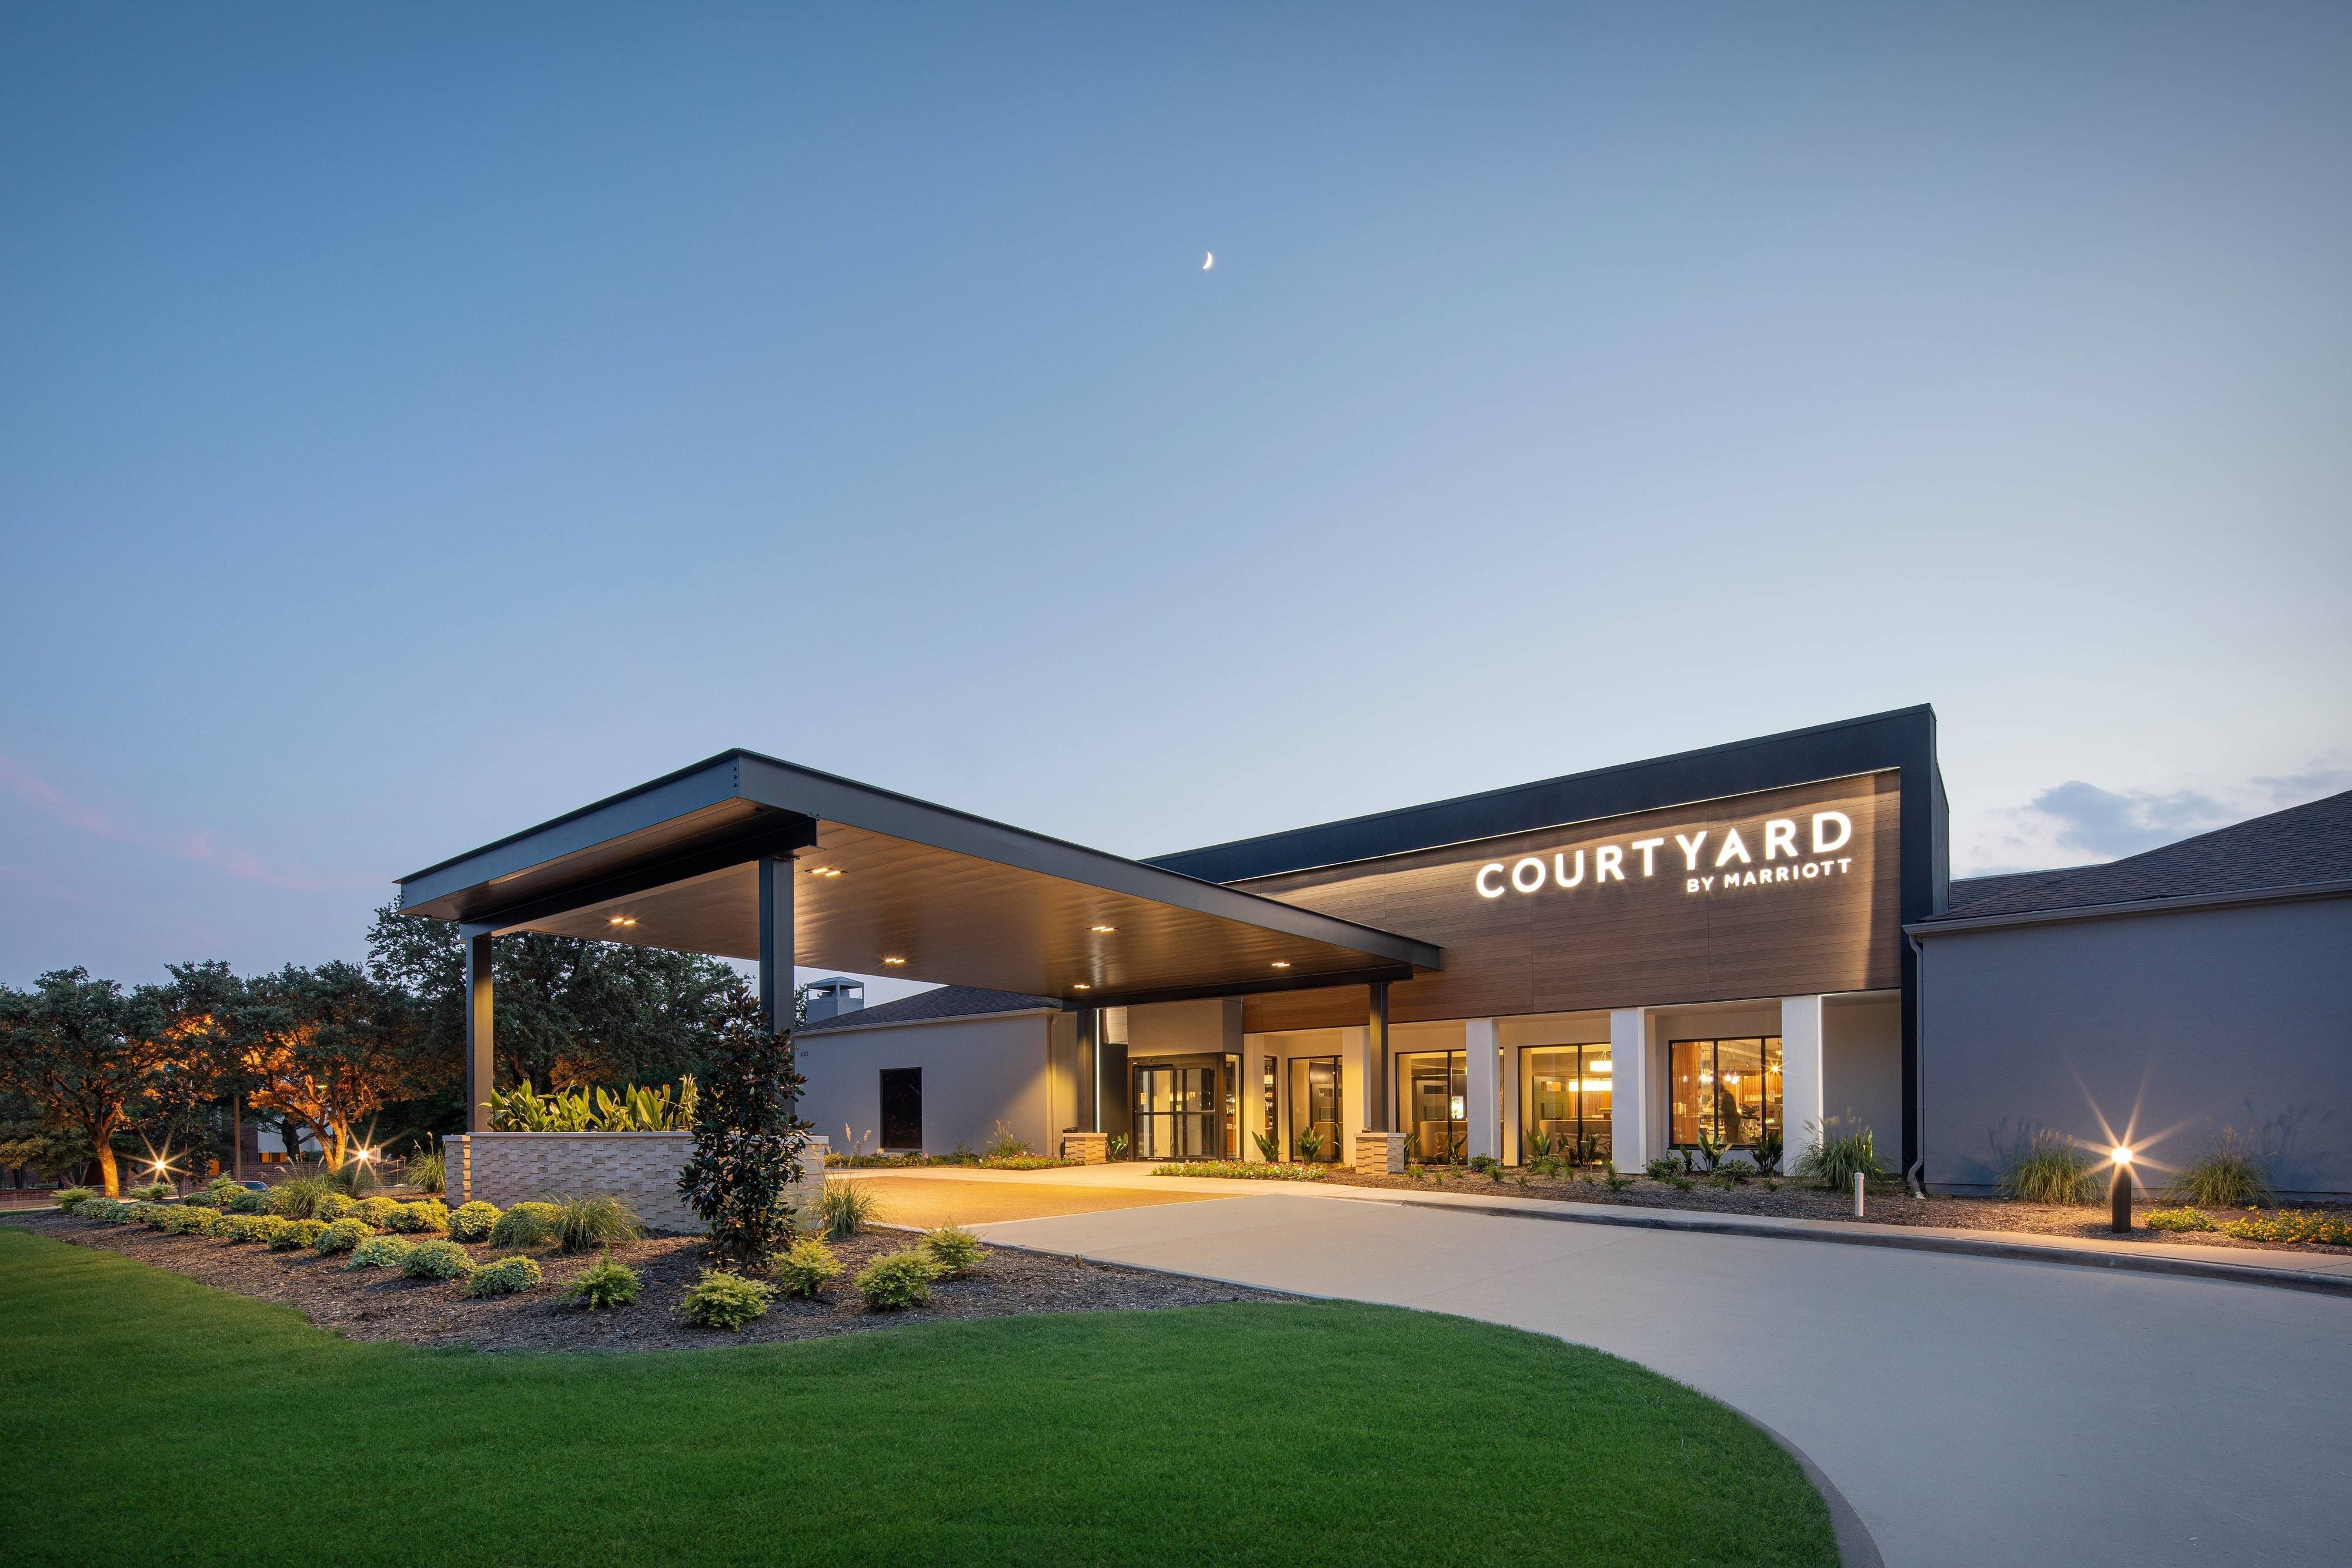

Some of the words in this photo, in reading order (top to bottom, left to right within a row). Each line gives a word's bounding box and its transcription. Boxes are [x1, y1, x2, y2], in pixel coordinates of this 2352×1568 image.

[1476, 811, 1852, 898] COURTYARD
[1687, 876, 1715, 892] BY
[1724, 858, 1852, 888] MARRIOTT
